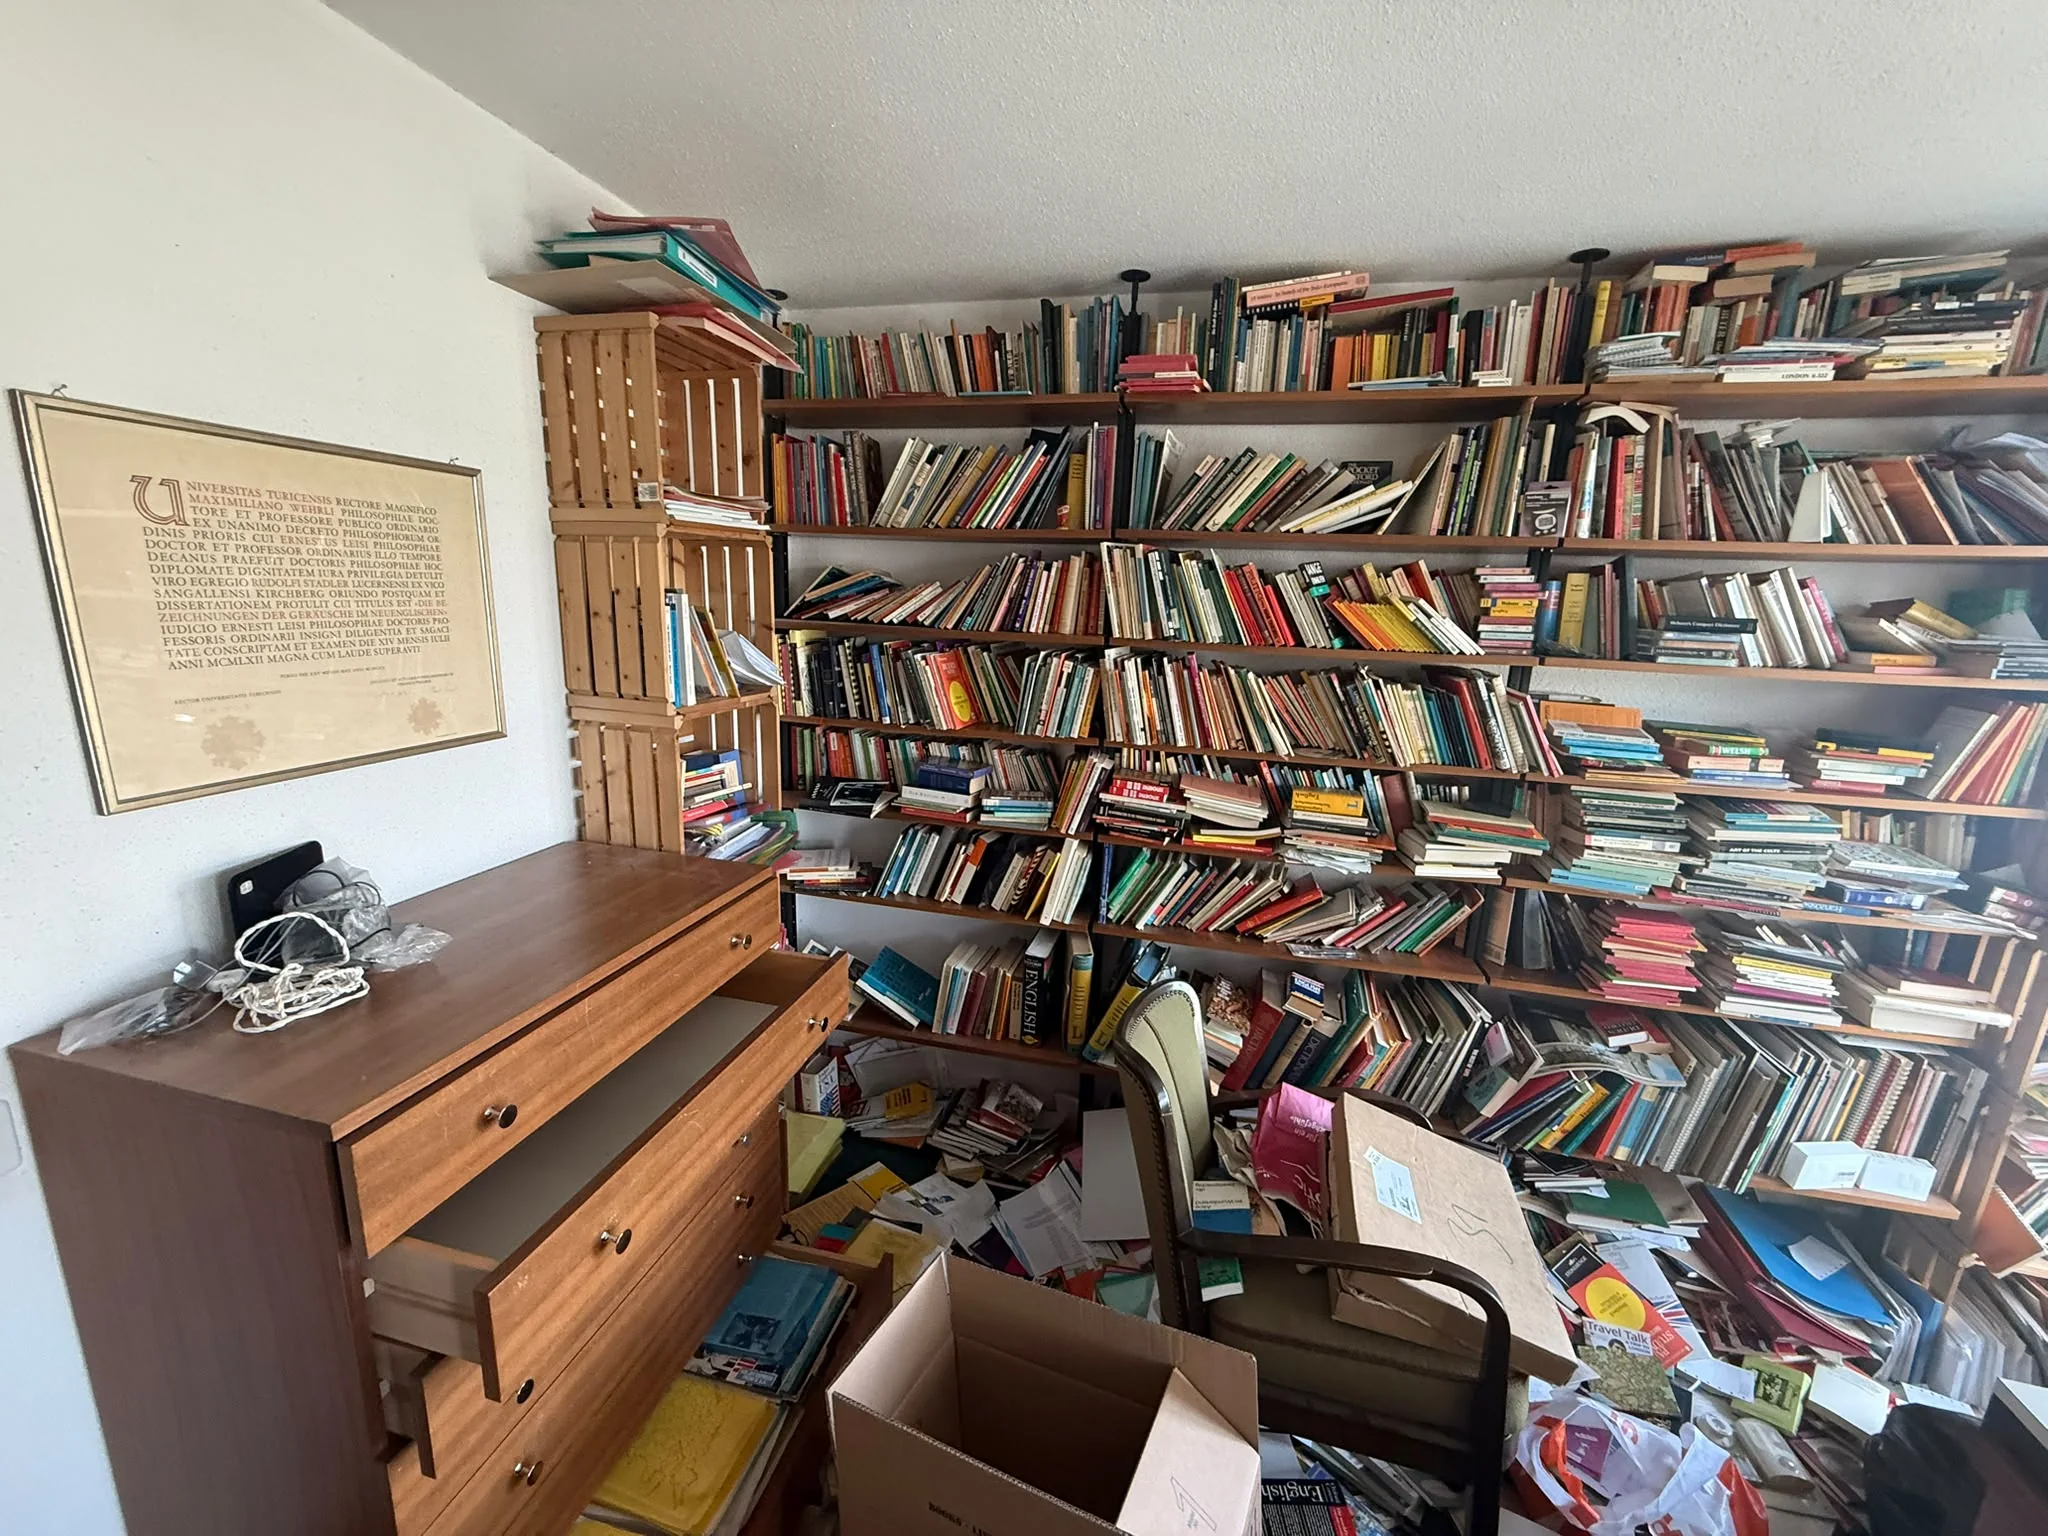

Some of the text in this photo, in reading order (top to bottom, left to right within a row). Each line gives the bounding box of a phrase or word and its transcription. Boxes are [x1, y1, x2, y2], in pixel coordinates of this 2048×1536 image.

[1023, 968, 1039, 1035] ENGLISH
[1587, 1321, 1622, 1338] Travel
[1625, 1330, 1650, 1346] Talk
[1261, 1480, 1325, 1503] English
